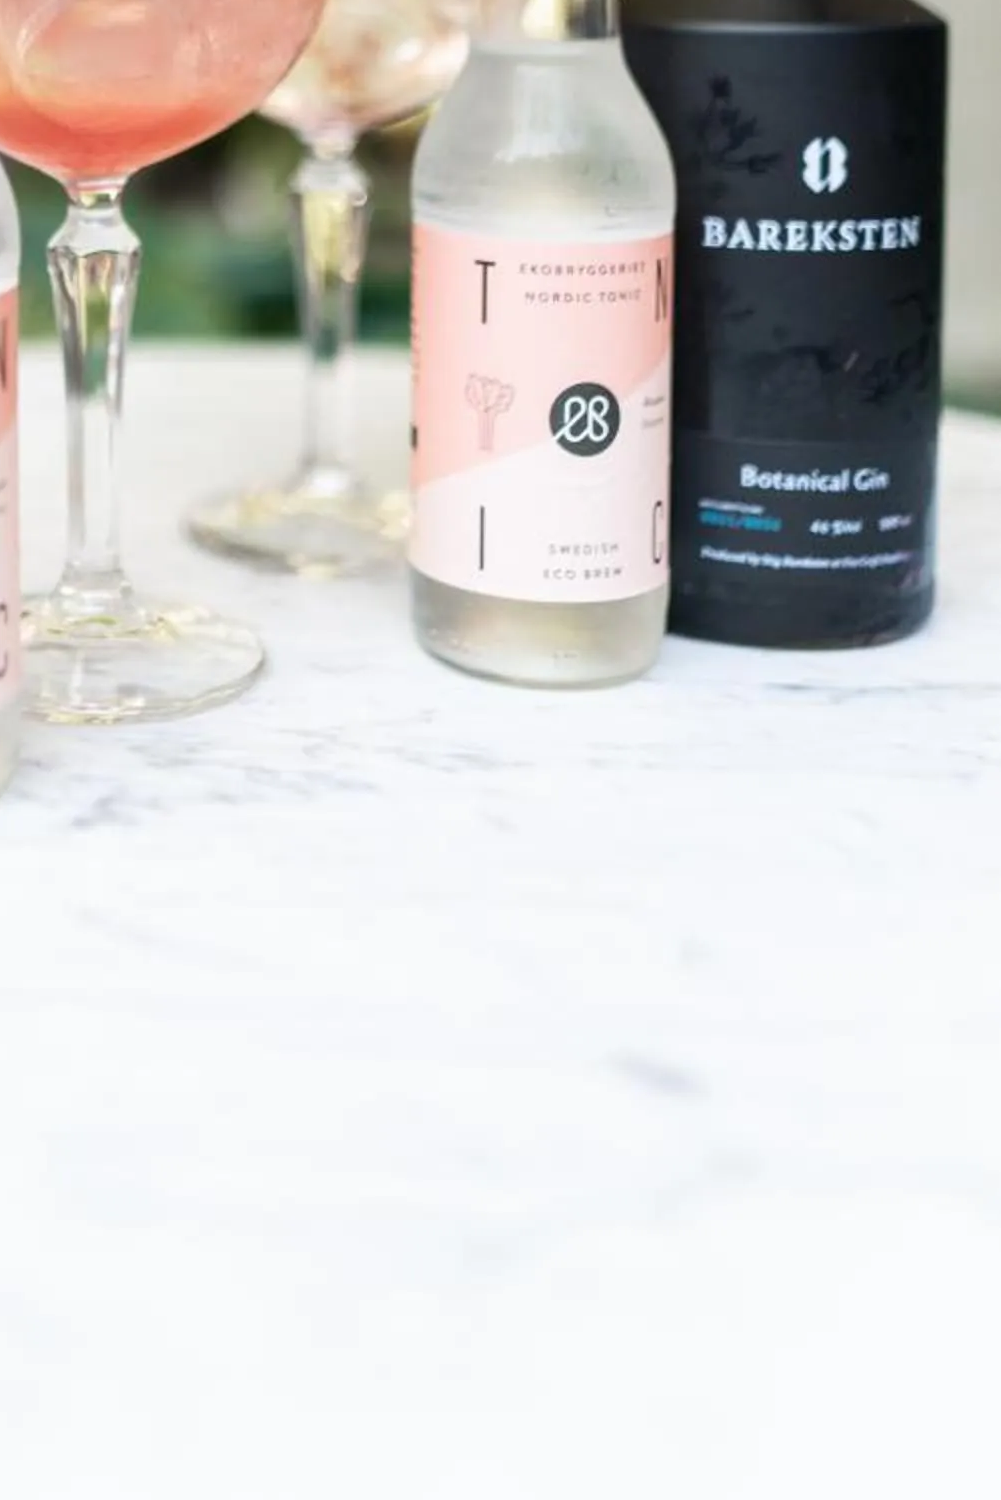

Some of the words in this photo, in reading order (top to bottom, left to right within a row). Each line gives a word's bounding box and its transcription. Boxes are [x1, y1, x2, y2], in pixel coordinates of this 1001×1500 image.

[702, 215, 921, 252] BAREKSTEN
[474, 259, 496, 325] T
[740, 463, 850, 493] Botanical
[852, 467, 890, 491] Gin
